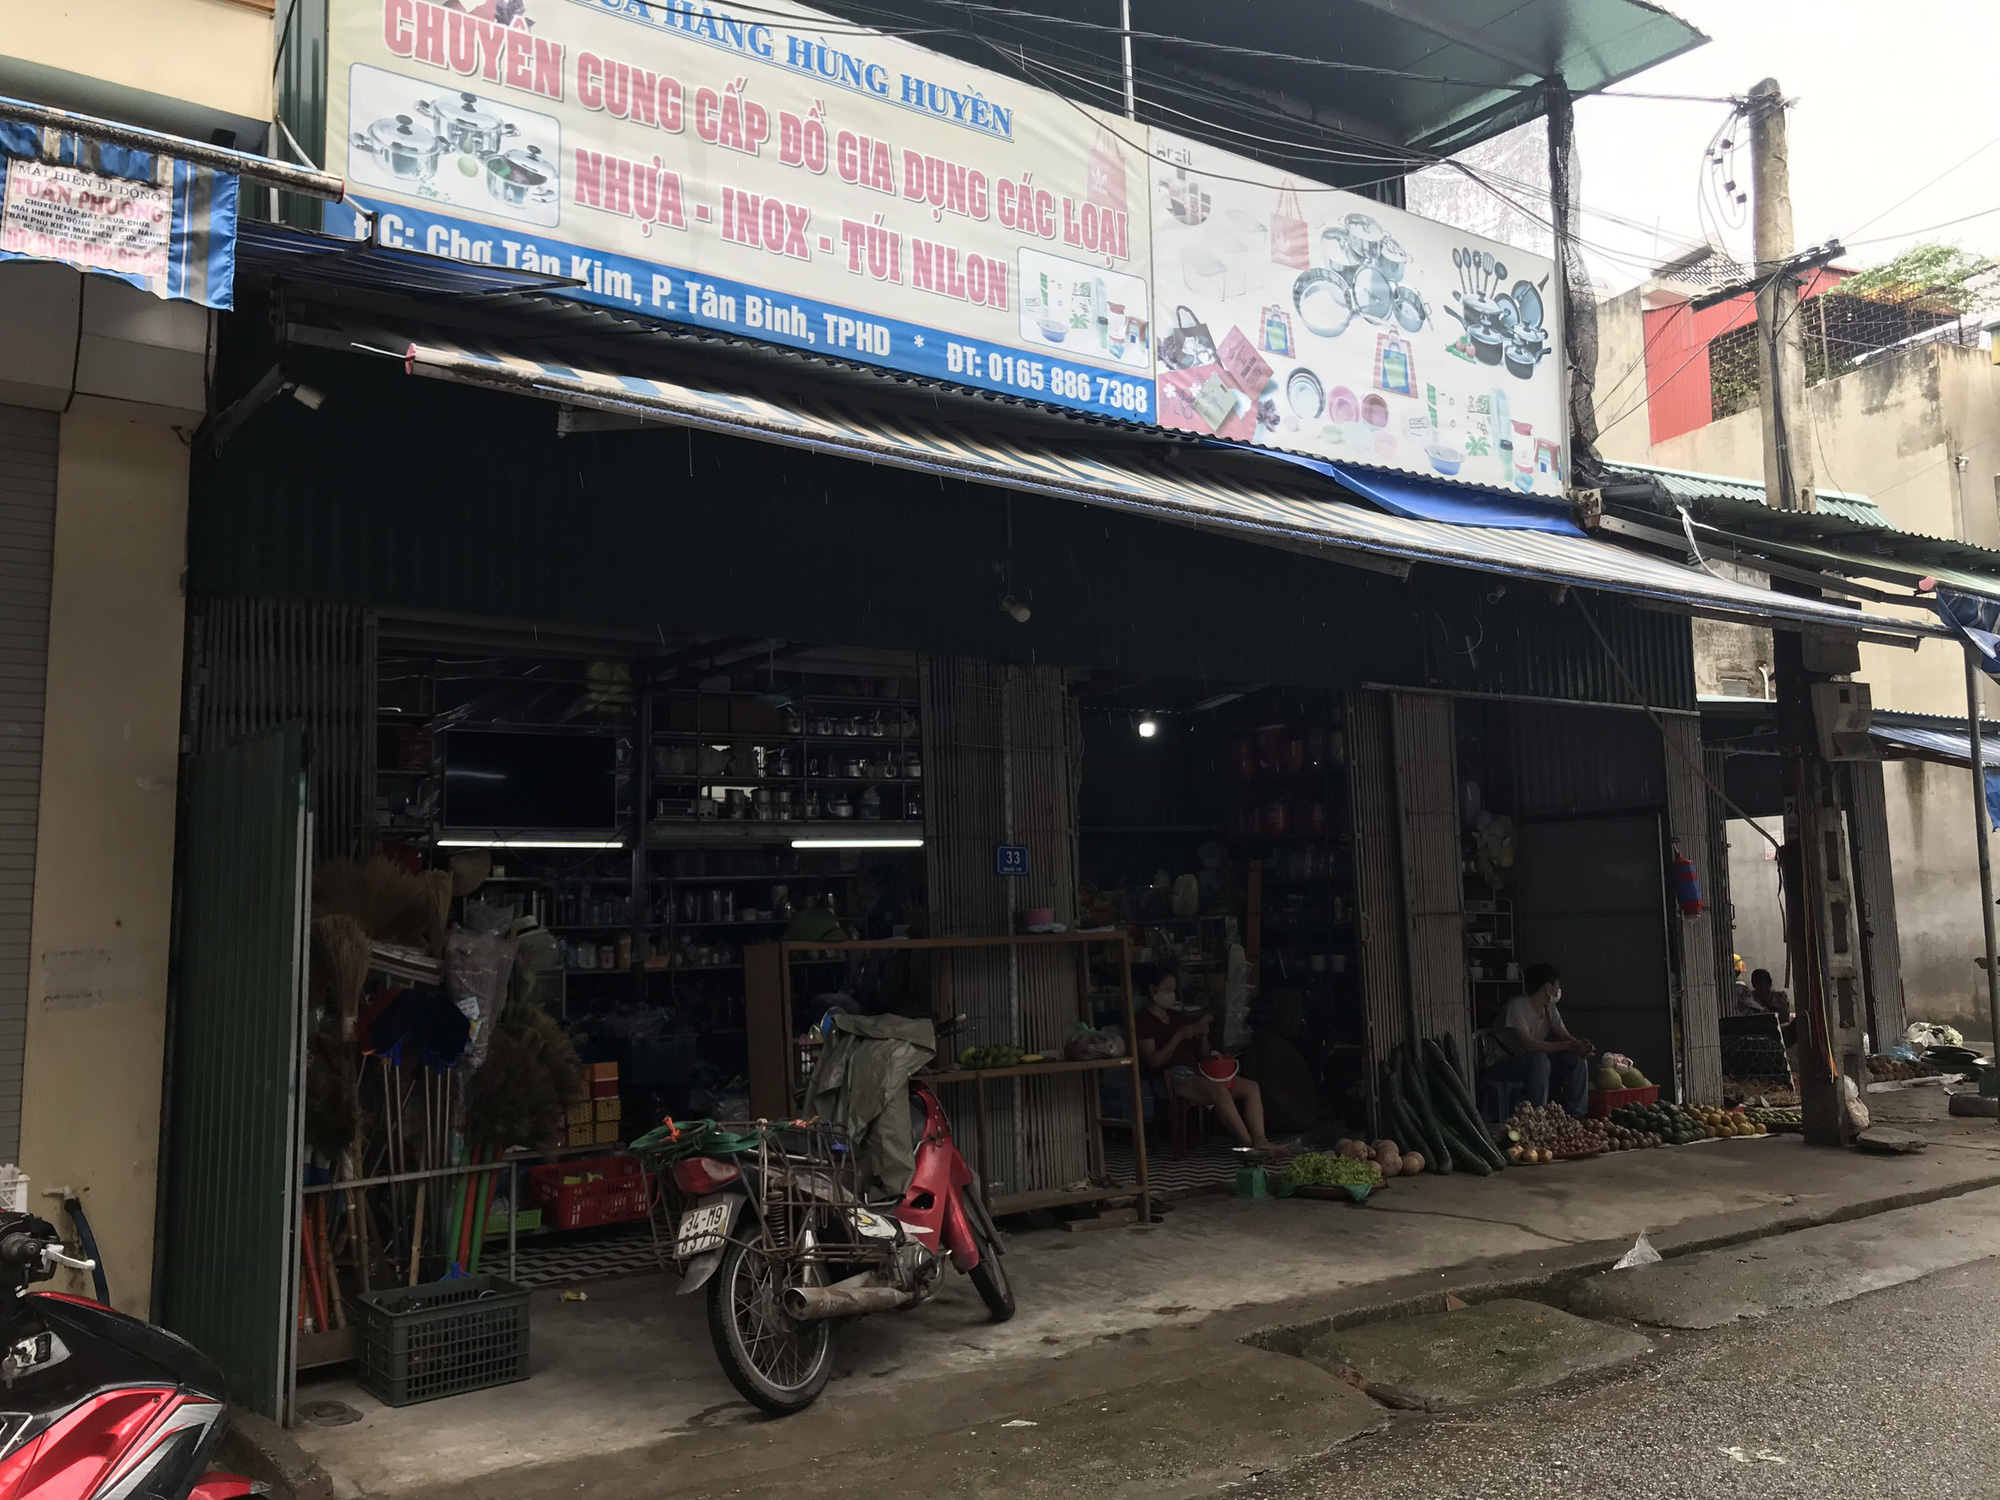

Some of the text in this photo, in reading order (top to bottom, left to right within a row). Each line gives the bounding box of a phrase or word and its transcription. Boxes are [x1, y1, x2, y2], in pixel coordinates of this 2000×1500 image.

[384, 0, 1129, 268] CHUYÊN CUNG CẤP ĐỒ GIA DỤNG CÁC LOẠI
[664, 0, 773, 57] HÀNG
[786, 35, 889, 96] HÙNG
[900, 73, 1013, 138] HUYỀN
[574, 147, 687, 237] NHỰA
[721, 187, 810, 261] INOX
[841, 213, 903, 285] TÚI
[912, 237, 1009, 312] NILON
[502, 239, 560, 278] Tân
[571, 254, 641, 306] Kim,
[651, 273, 675, 310] P.
[685, 280, 737, 324] Tân
[745, 293, 815, 345] Bình,
[822, 312, 891, 357] TPHD
[946, 341, 981, 378] ĐT:
[988, 353, 1045, 391] 0165
[1051, 367, 1091, 402] 886
[1096, 376, 1148, 414] 7388
[1006, 850, 1021, 865] 33
